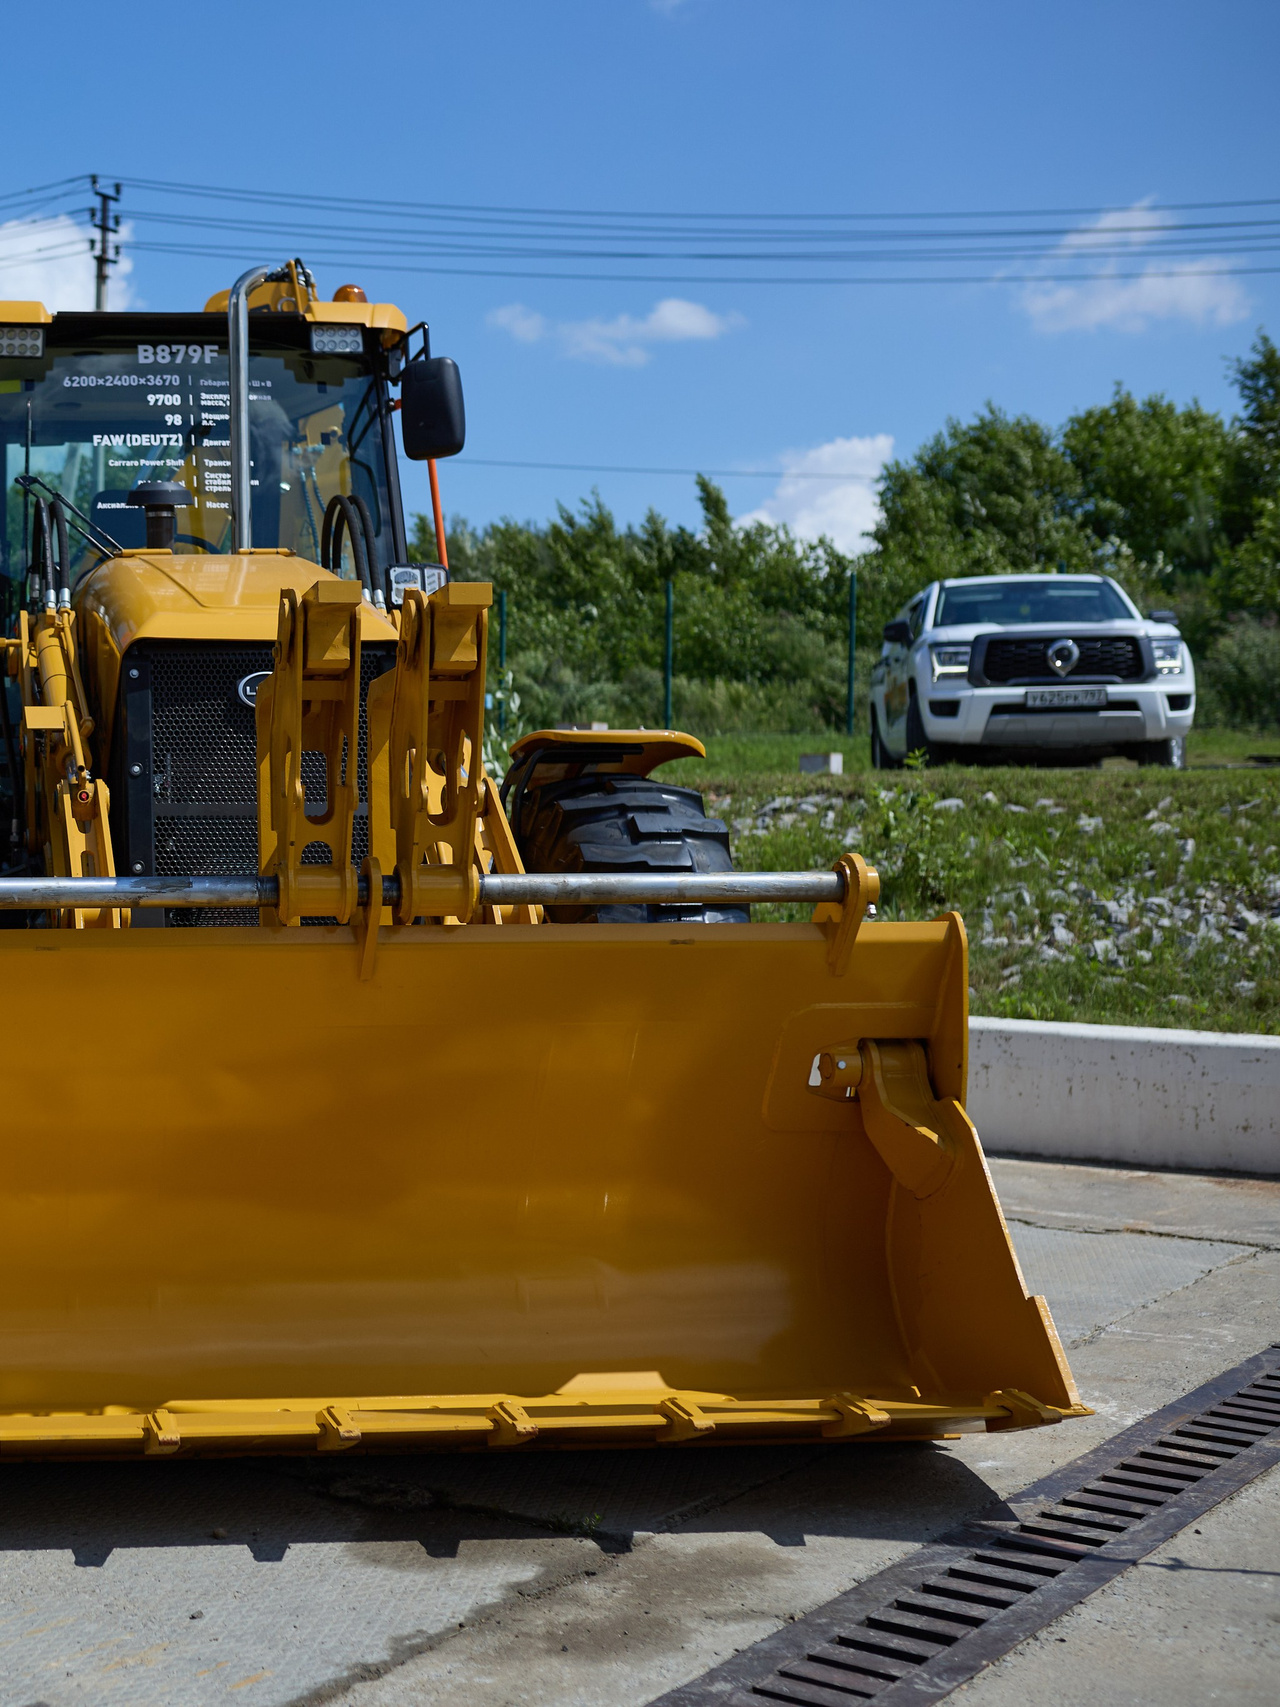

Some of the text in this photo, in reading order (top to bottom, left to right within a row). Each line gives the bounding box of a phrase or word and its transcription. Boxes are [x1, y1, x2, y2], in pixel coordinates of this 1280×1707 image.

[137, 344, 219, 364] B879F
[147, 393, 182, 406] 9700
[164, 414, 183, 426] 98
[92, 433, 183, 447] FAW (DEUTZ)
[140, 459, 165, 467] Power
